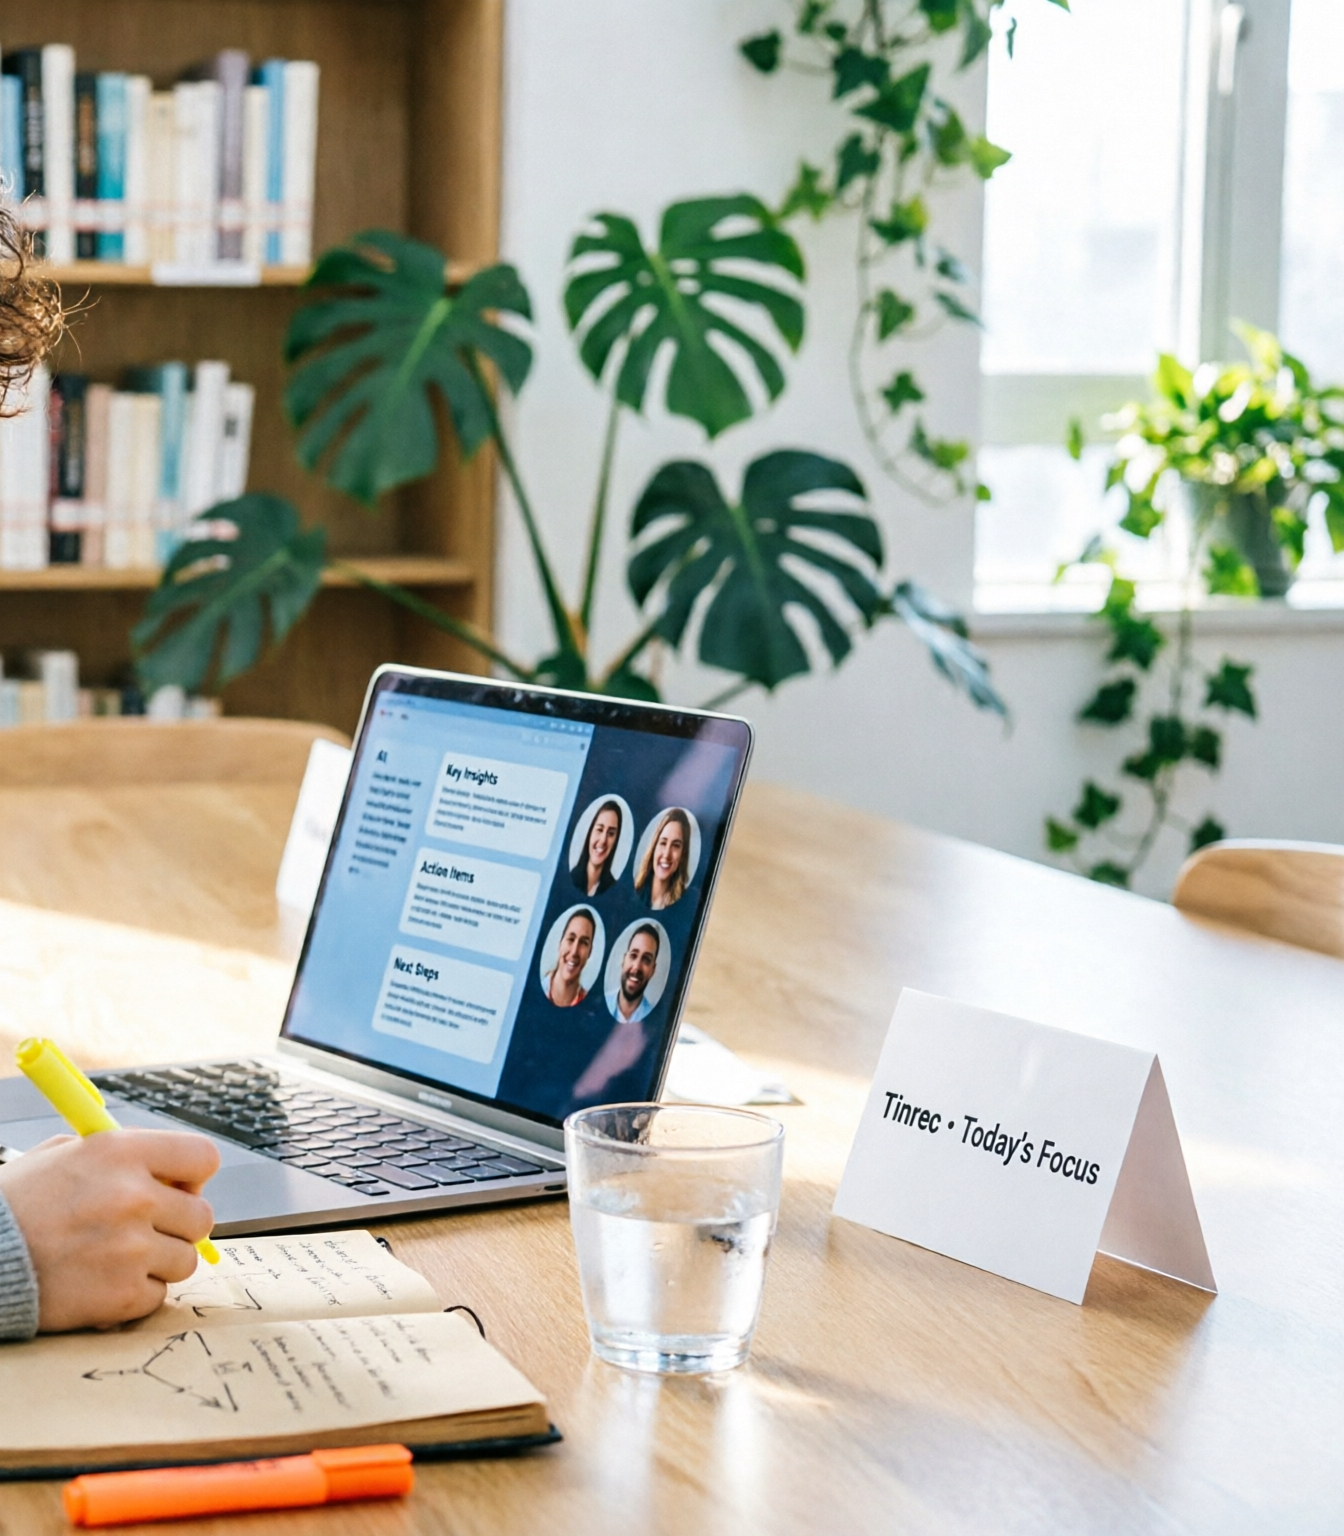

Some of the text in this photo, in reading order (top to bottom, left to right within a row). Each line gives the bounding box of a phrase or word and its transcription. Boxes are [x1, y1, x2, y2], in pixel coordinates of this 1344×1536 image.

[446, 764, 498, 786] Key Insights
[420, 860, 475, 884] Action Items
[883, 1091, 942, 1134] Tinrec
[961, 1114, 1034, 1166] Today's
[1036, 1139, 1101, 1185] Focus
